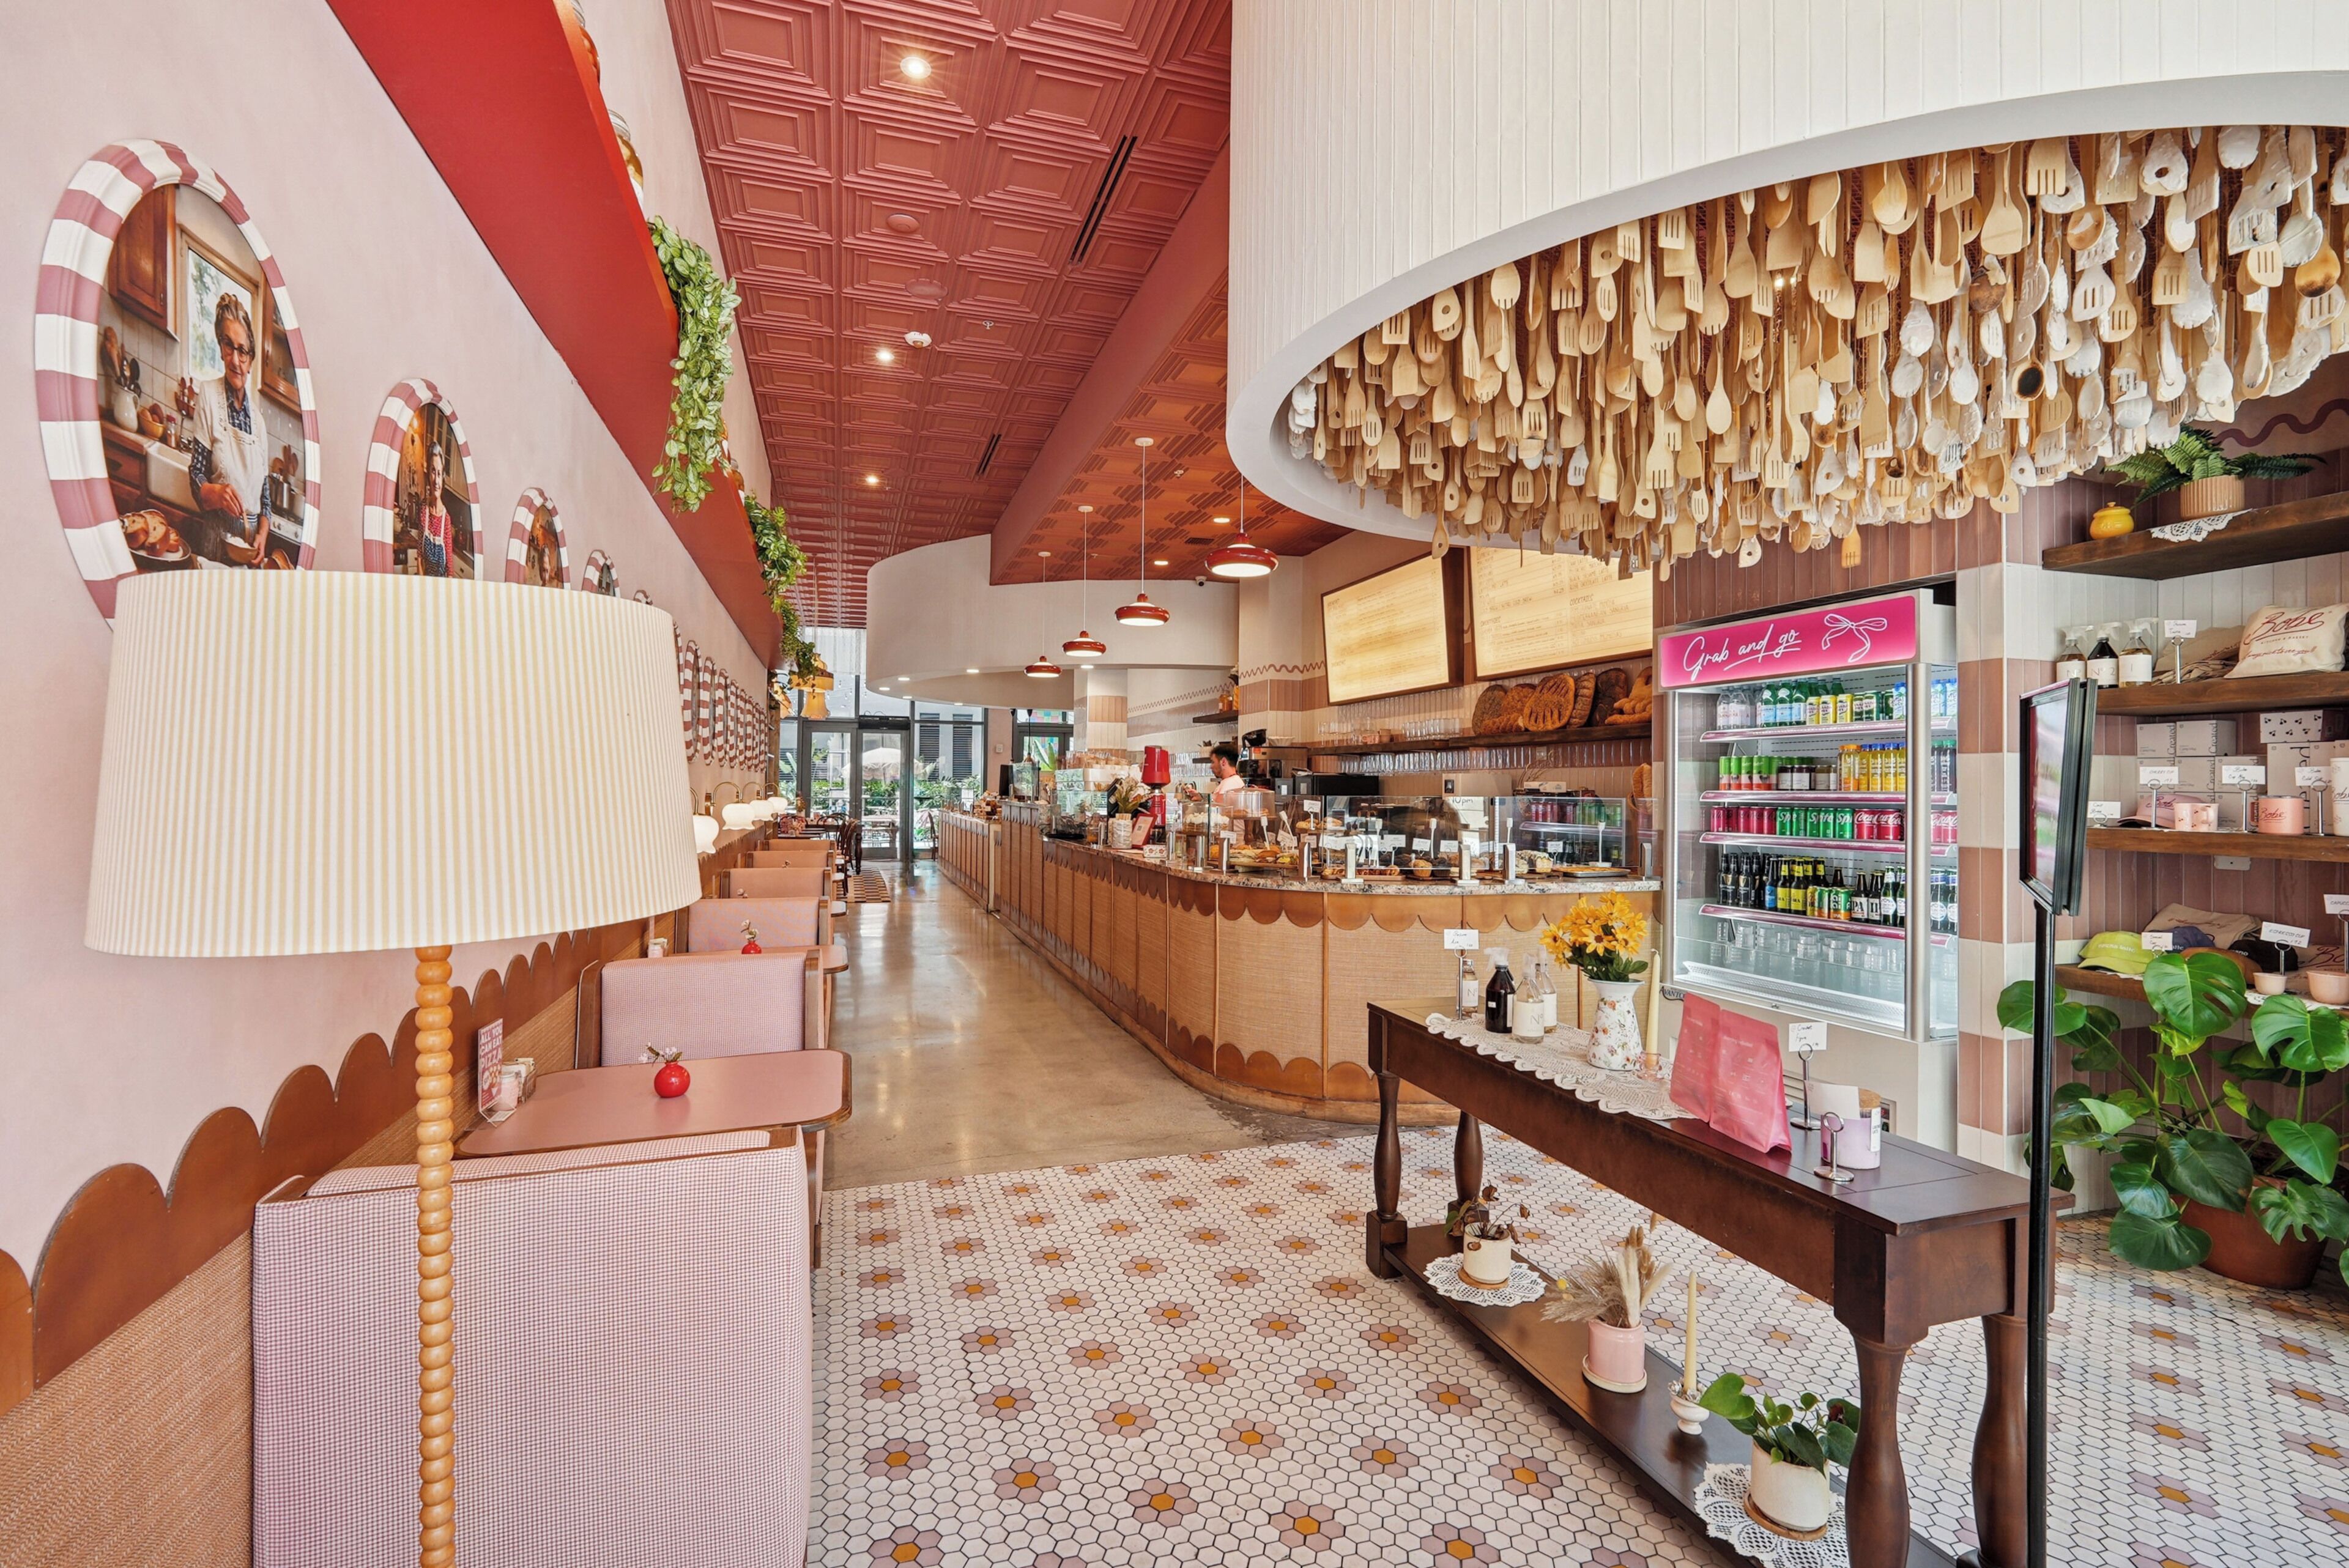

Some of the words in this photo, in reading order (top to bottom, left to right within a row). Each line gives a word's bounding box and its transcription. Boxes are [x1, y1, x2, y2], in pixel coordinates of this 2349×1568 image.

[1569, 593, 1594, 606] COCKTAILS
[2243, 608, 2325, 645] Bobe
[1683, 635, 1729, 682] Grab
[1737, 623, 1775, 664] and
[1773, 629, 1802, 659] go
[2167, 724, 2176, 756] Created
[2208, 722, 2217, 755] Created
[2206, 759, 2216, 791] Created
[2260, 807, 2287, 822] Bobe
[480, 1030, 491, 1045] ALL
[492, 1025, 503, 1038] YOU
[480, 1040, 492, 1054] CAN
[492, 1035, 503, 1048] EAT
[481, 1047, 503, 1068] PIZZA
